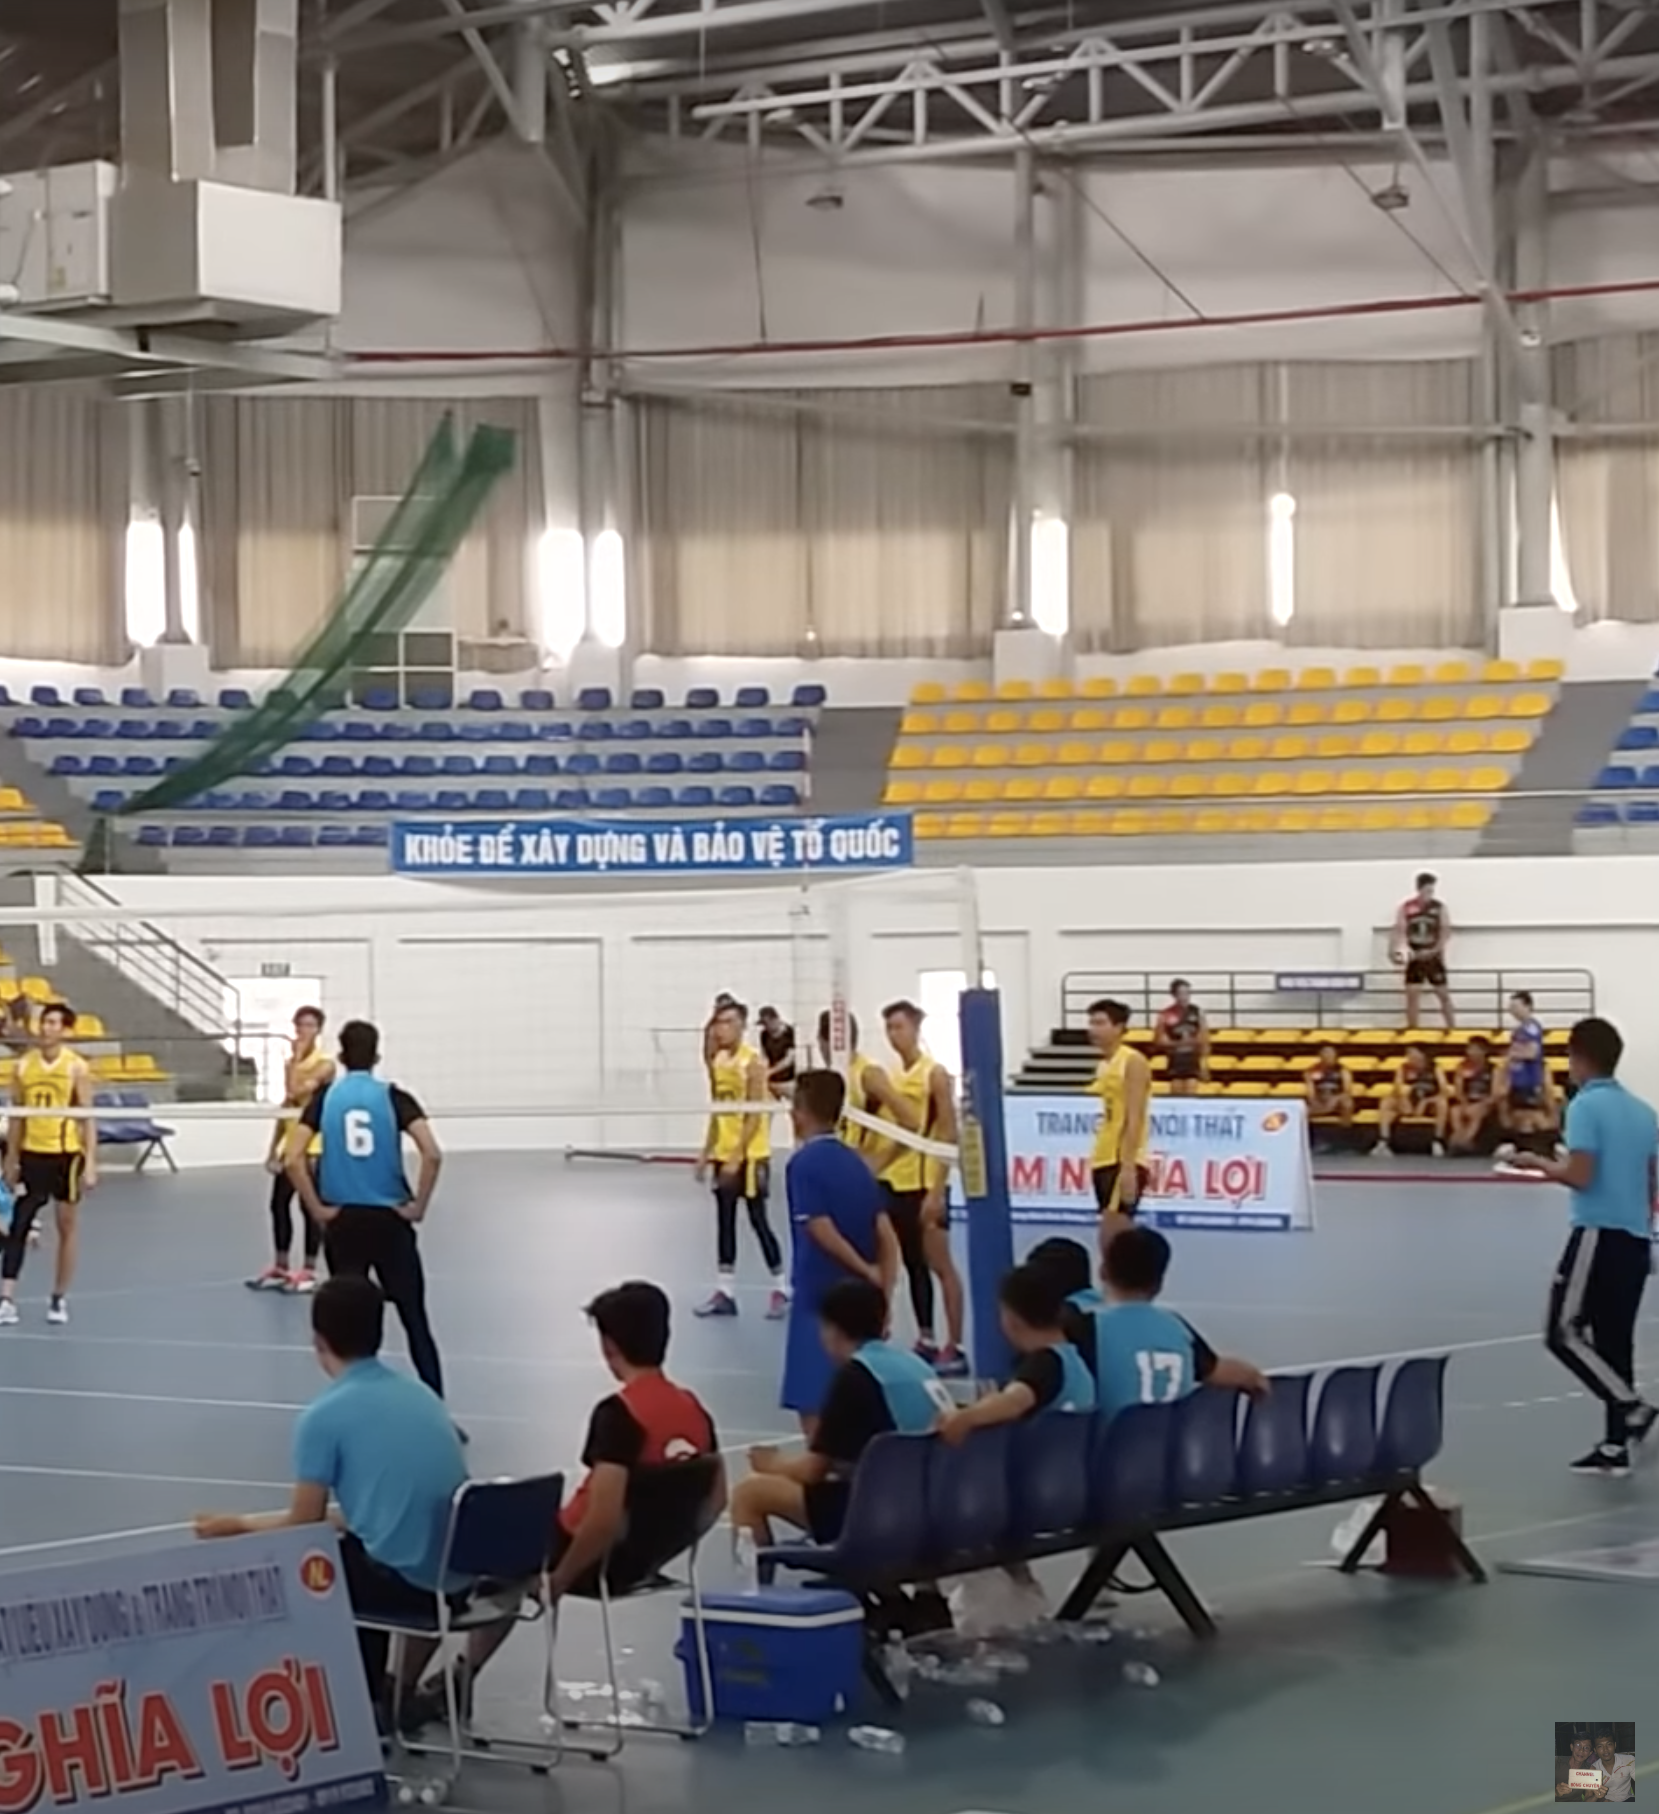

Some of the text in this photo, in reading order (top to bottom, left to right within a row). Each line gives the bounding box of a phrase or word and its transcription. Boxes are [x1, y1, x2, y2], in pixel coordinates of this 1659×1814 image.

[405, 817, 901, 871] KHỎE ĐỂ XÂY DỰNG VÀ BẢO VỆ TỔ QUỐC
[345, 1109, 374, 1157] 6
[1207, 1155, 1264, 1208] LỢI
[1136, 1351, 1183, 1404] 17
[212, 1657, 339, 1779] LỢI
